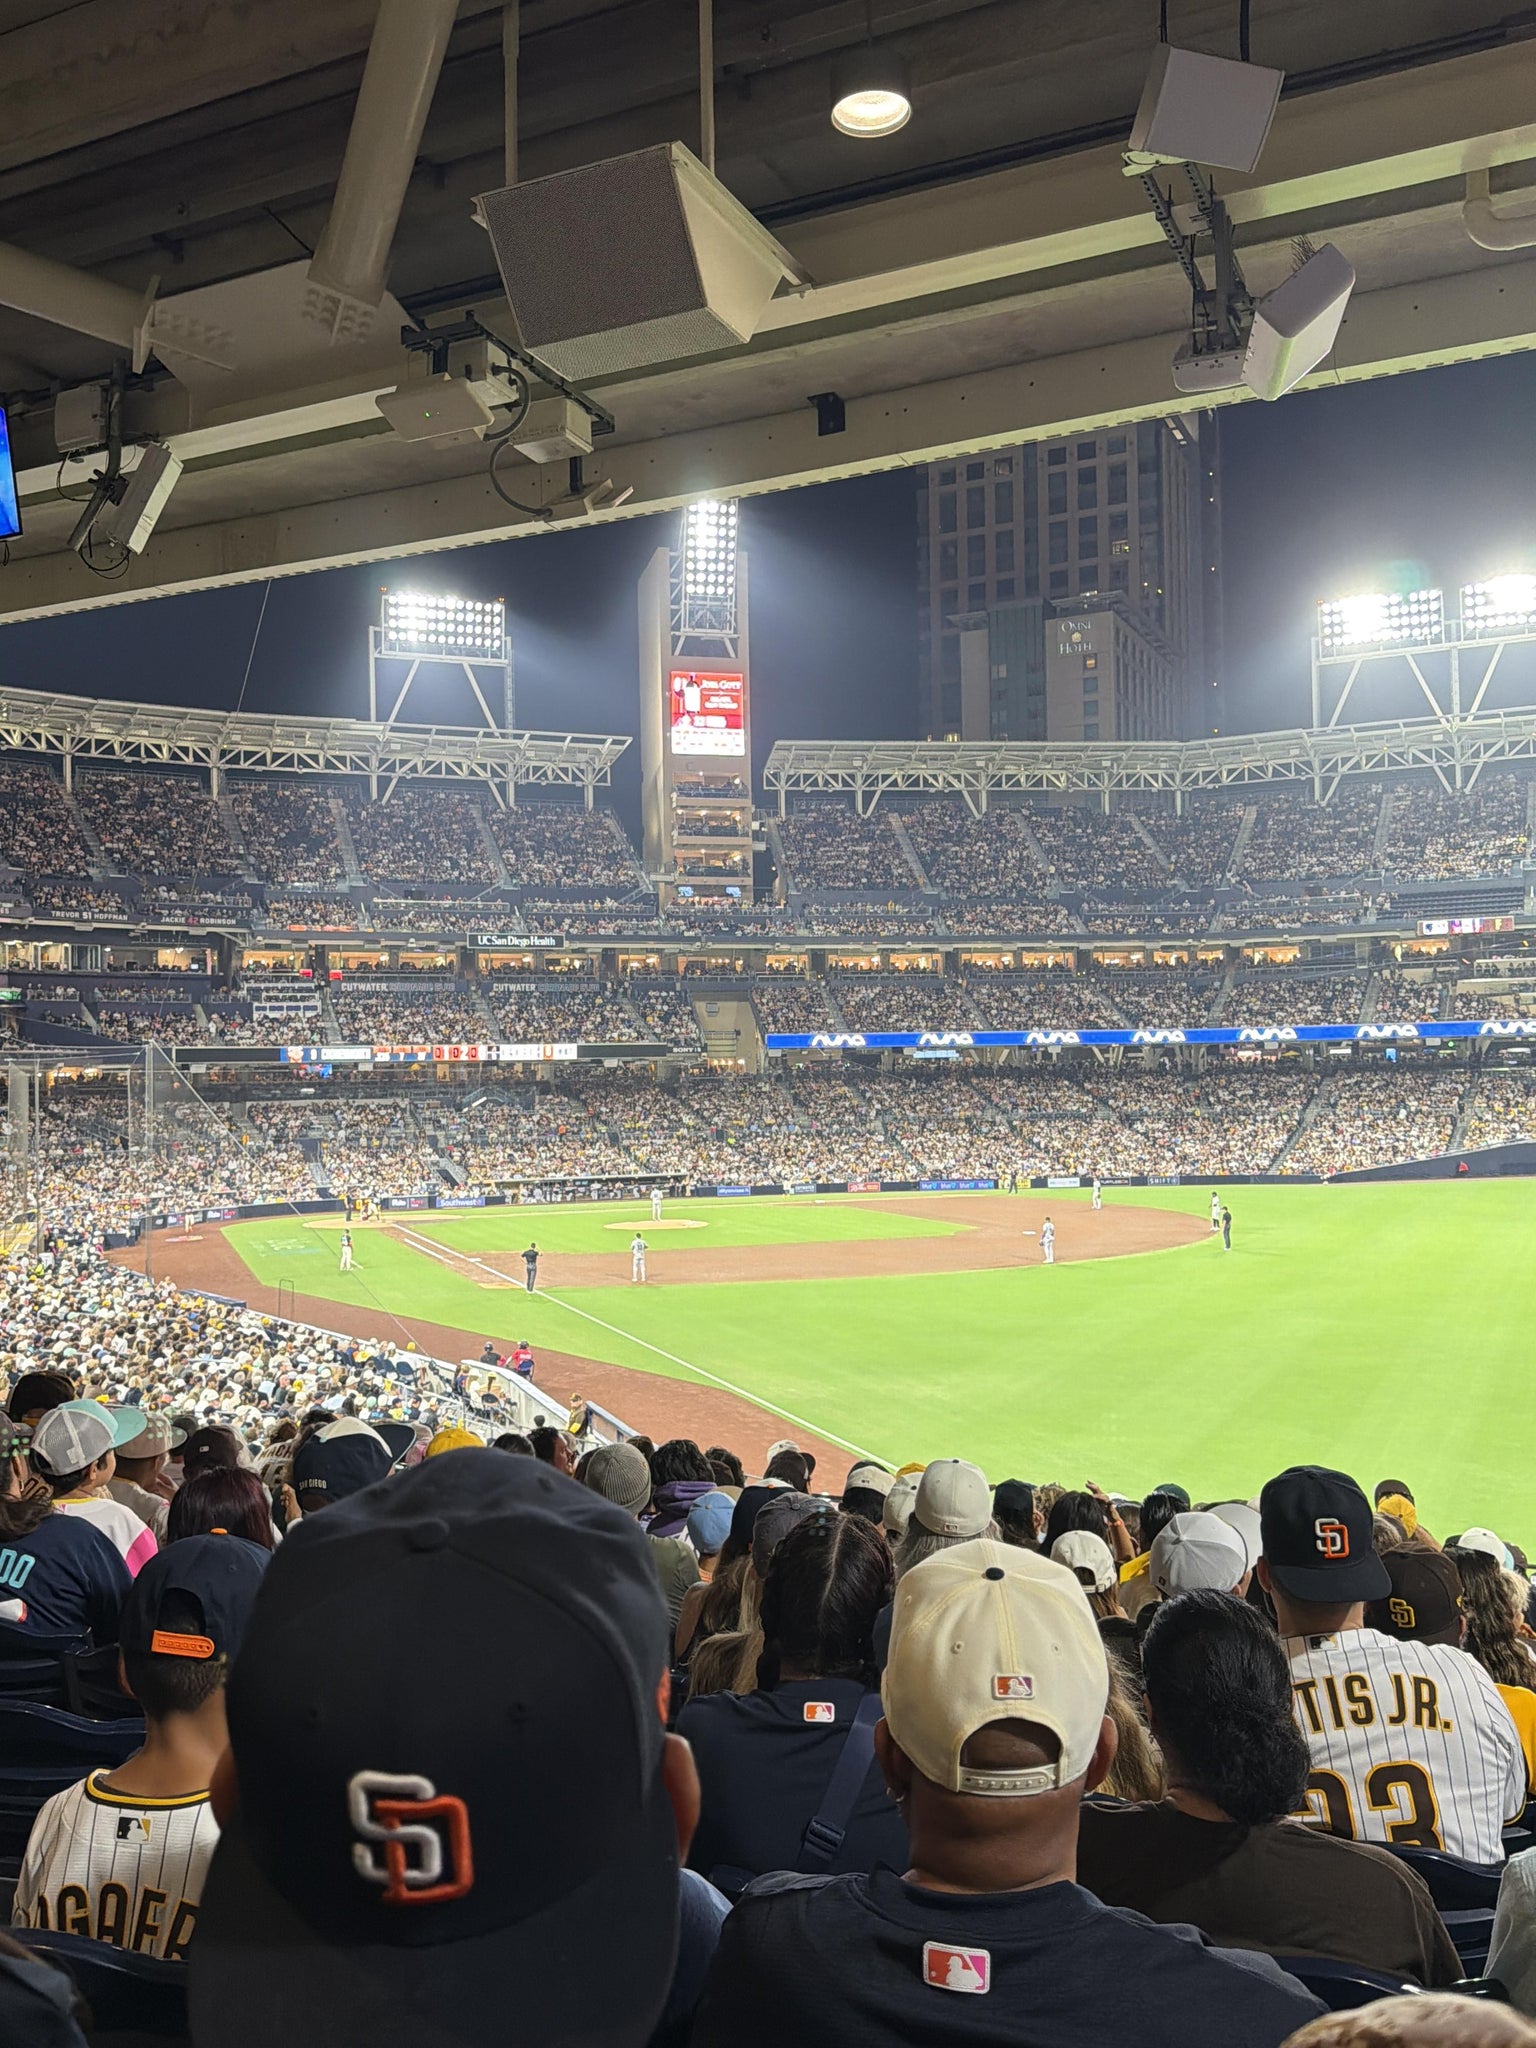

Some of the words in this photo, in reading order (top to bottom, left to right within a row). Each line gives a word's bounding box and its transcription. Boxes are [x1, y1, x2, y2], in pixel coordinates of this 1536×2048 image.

[1061, 621, 1091, 632] OMNI
[51, 911, 80, 919] TREVOR
[82, 911, 92, 920] 51
[94, 913, 128, 921] HOFFMAN
[188, 917, 198, 925] 42
[200, 917, 237, 926] ROBINSON
[478, 935, 491, 945] UC
[491, 935, 507, 945] San
[507, 935, 530, 947] Diego
[530, 935, 556, 946] Health
[341, 982, 388, 992] CUTWATER
[493, 983, 536, 992] CUTWATER
[441, 1197, 477, 1207] Southwest
[1292, 1672, 1376, 1735] TIS
[1387, 1672, 1453, 1734] JR.
